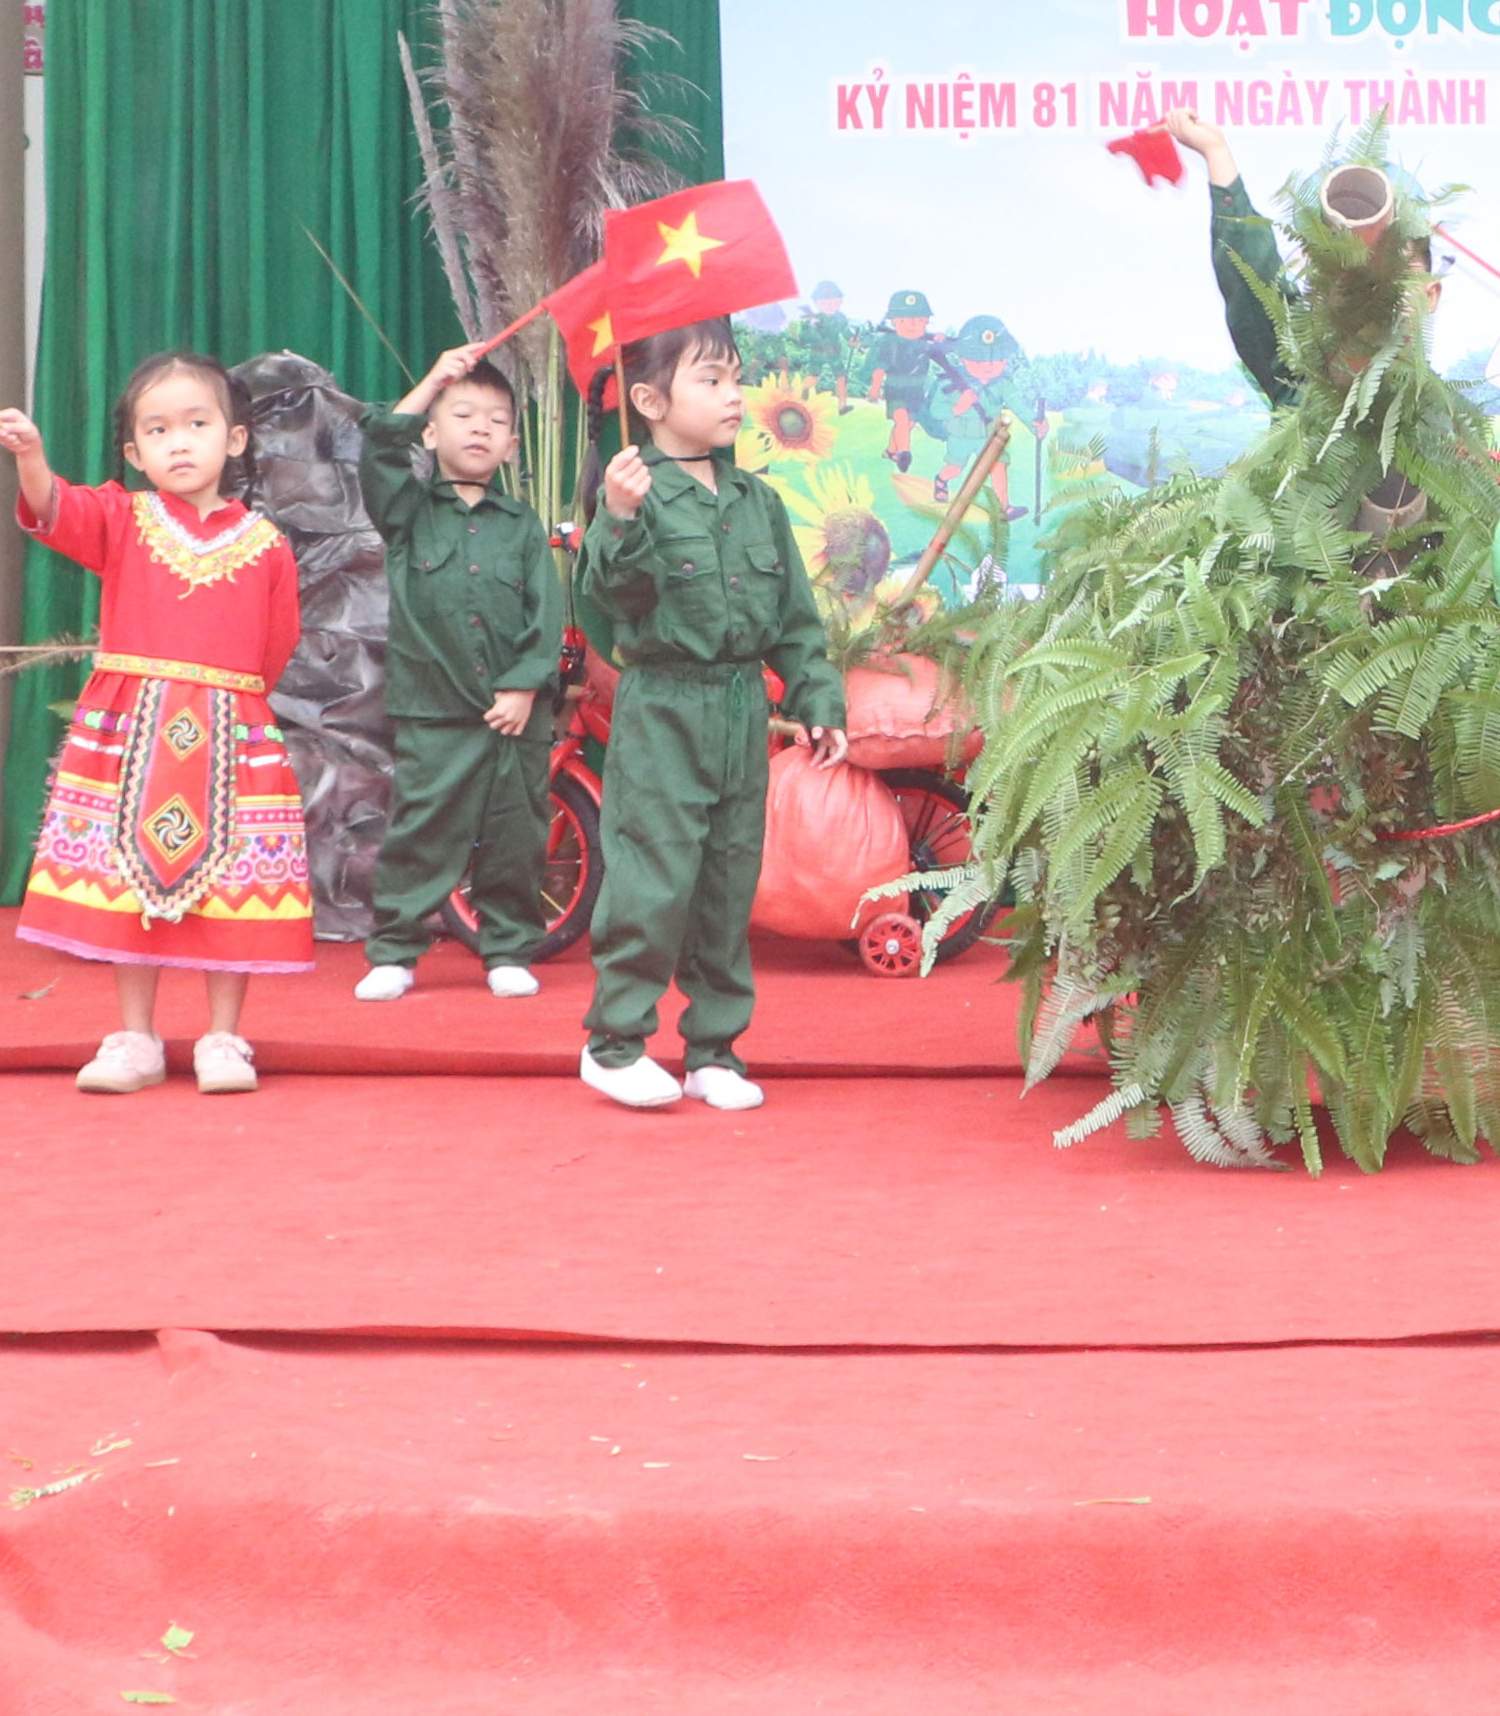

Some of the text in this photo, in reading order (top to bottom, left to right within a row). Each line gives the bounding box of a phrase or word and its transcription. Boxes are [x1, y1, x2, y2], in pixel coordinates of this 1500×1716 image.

[836, 68, 890, 130] KỶ
[906, 73, 1018, 139] NIỆM
[1032, 82, 1079, 128] 81
[1099, 70, 1198, 126] NĂM
[1214, 69, 1330, 127] NGÀY
[1343, 70, 1487, 126] THÀNH
